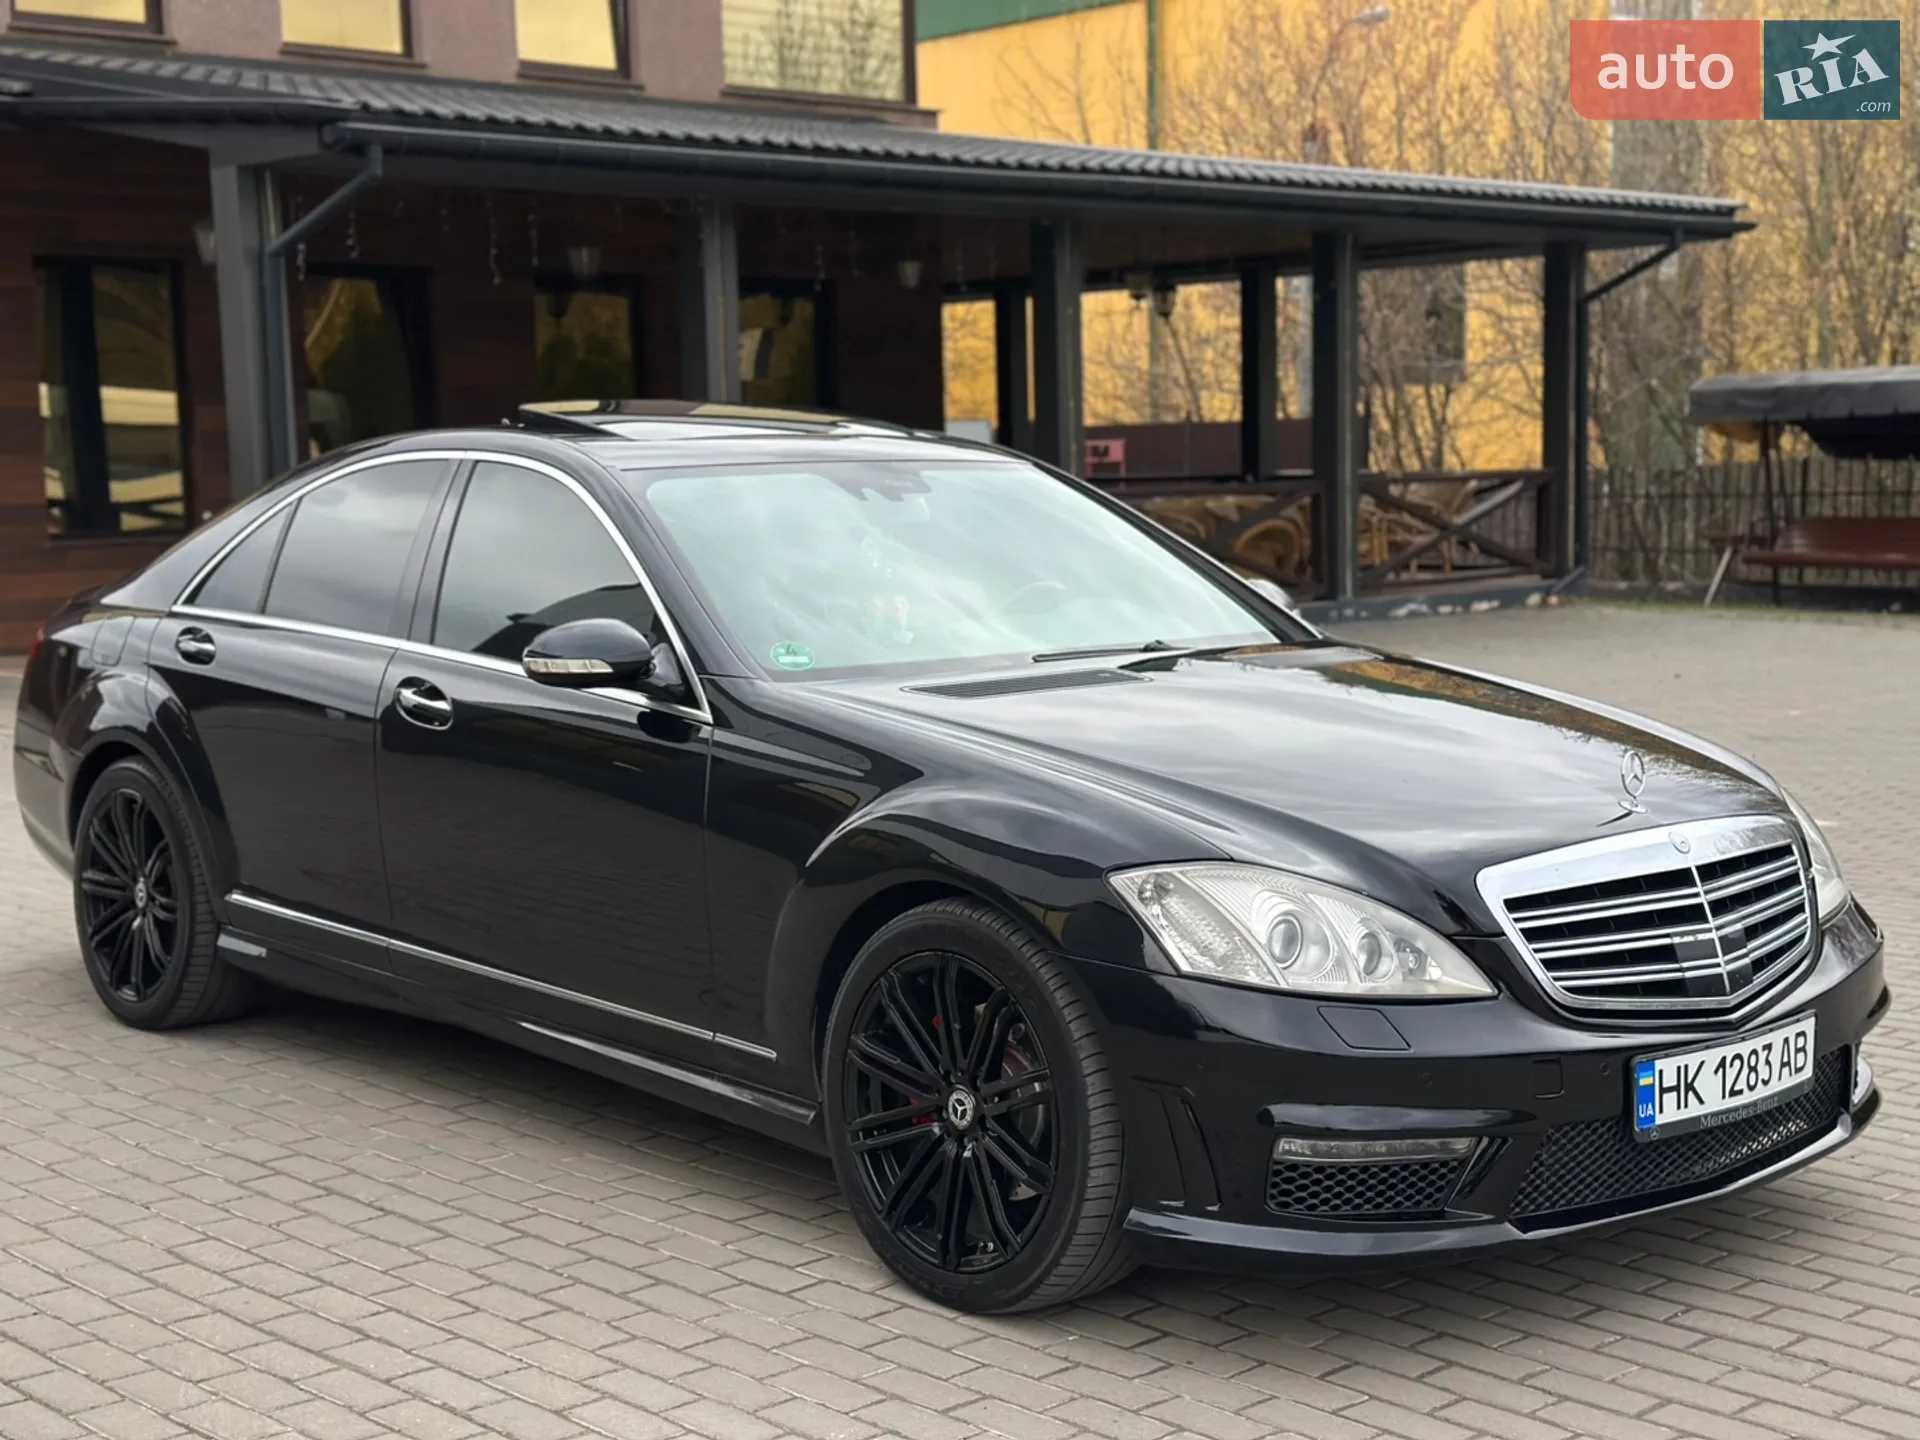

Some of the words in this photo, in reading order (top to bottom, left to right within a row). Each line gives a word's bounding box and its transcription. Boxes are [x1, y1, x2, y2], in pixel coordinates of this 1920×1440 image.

[1658, 1060, 1706, 1114] HK
[1713, 1042, 1773, 1100] 1283
[1778, 1030, 1808, 1082] AB
[1638, 1102, 1654, 1118] UA
